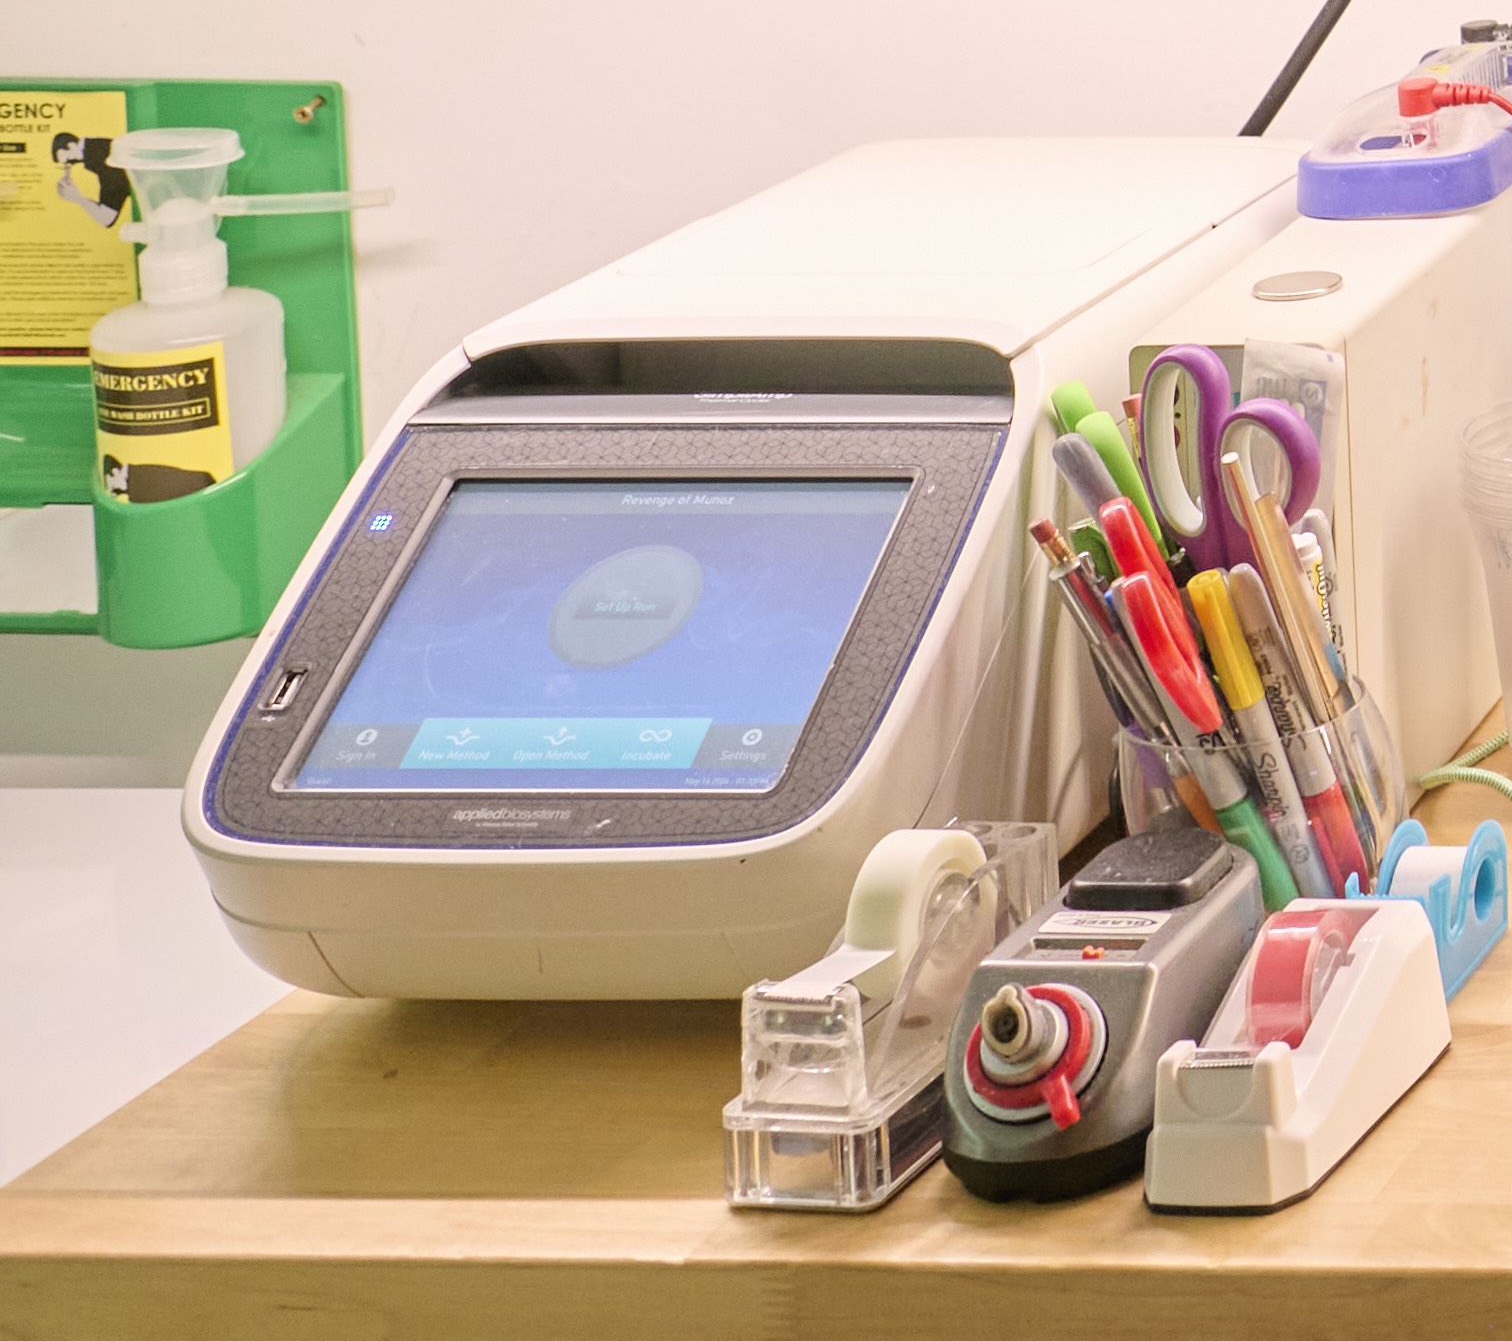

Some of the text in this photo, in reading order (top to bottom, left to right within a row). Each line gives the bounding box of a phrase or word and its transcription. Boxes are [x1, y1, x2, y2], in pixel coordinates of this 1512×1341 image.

[37, 124, 50, 133] KIT
[94, 368, 209, 391] EMERGENCY
[136, 410, 179, 420] BOTTLE
[181, 405, 204, 416] KIT
[621, 494, 735, 507] Revenge of Munoz
[594, 602, 656, 613] Set Up Run
[336, 750, 376, 763] Sign In
[418, 749, 490, 761] New Method
[513, 749, 590, 763] Open Method
[621, 749, 672, 761] Incubate
[720, 749, 766, 763] Settings
